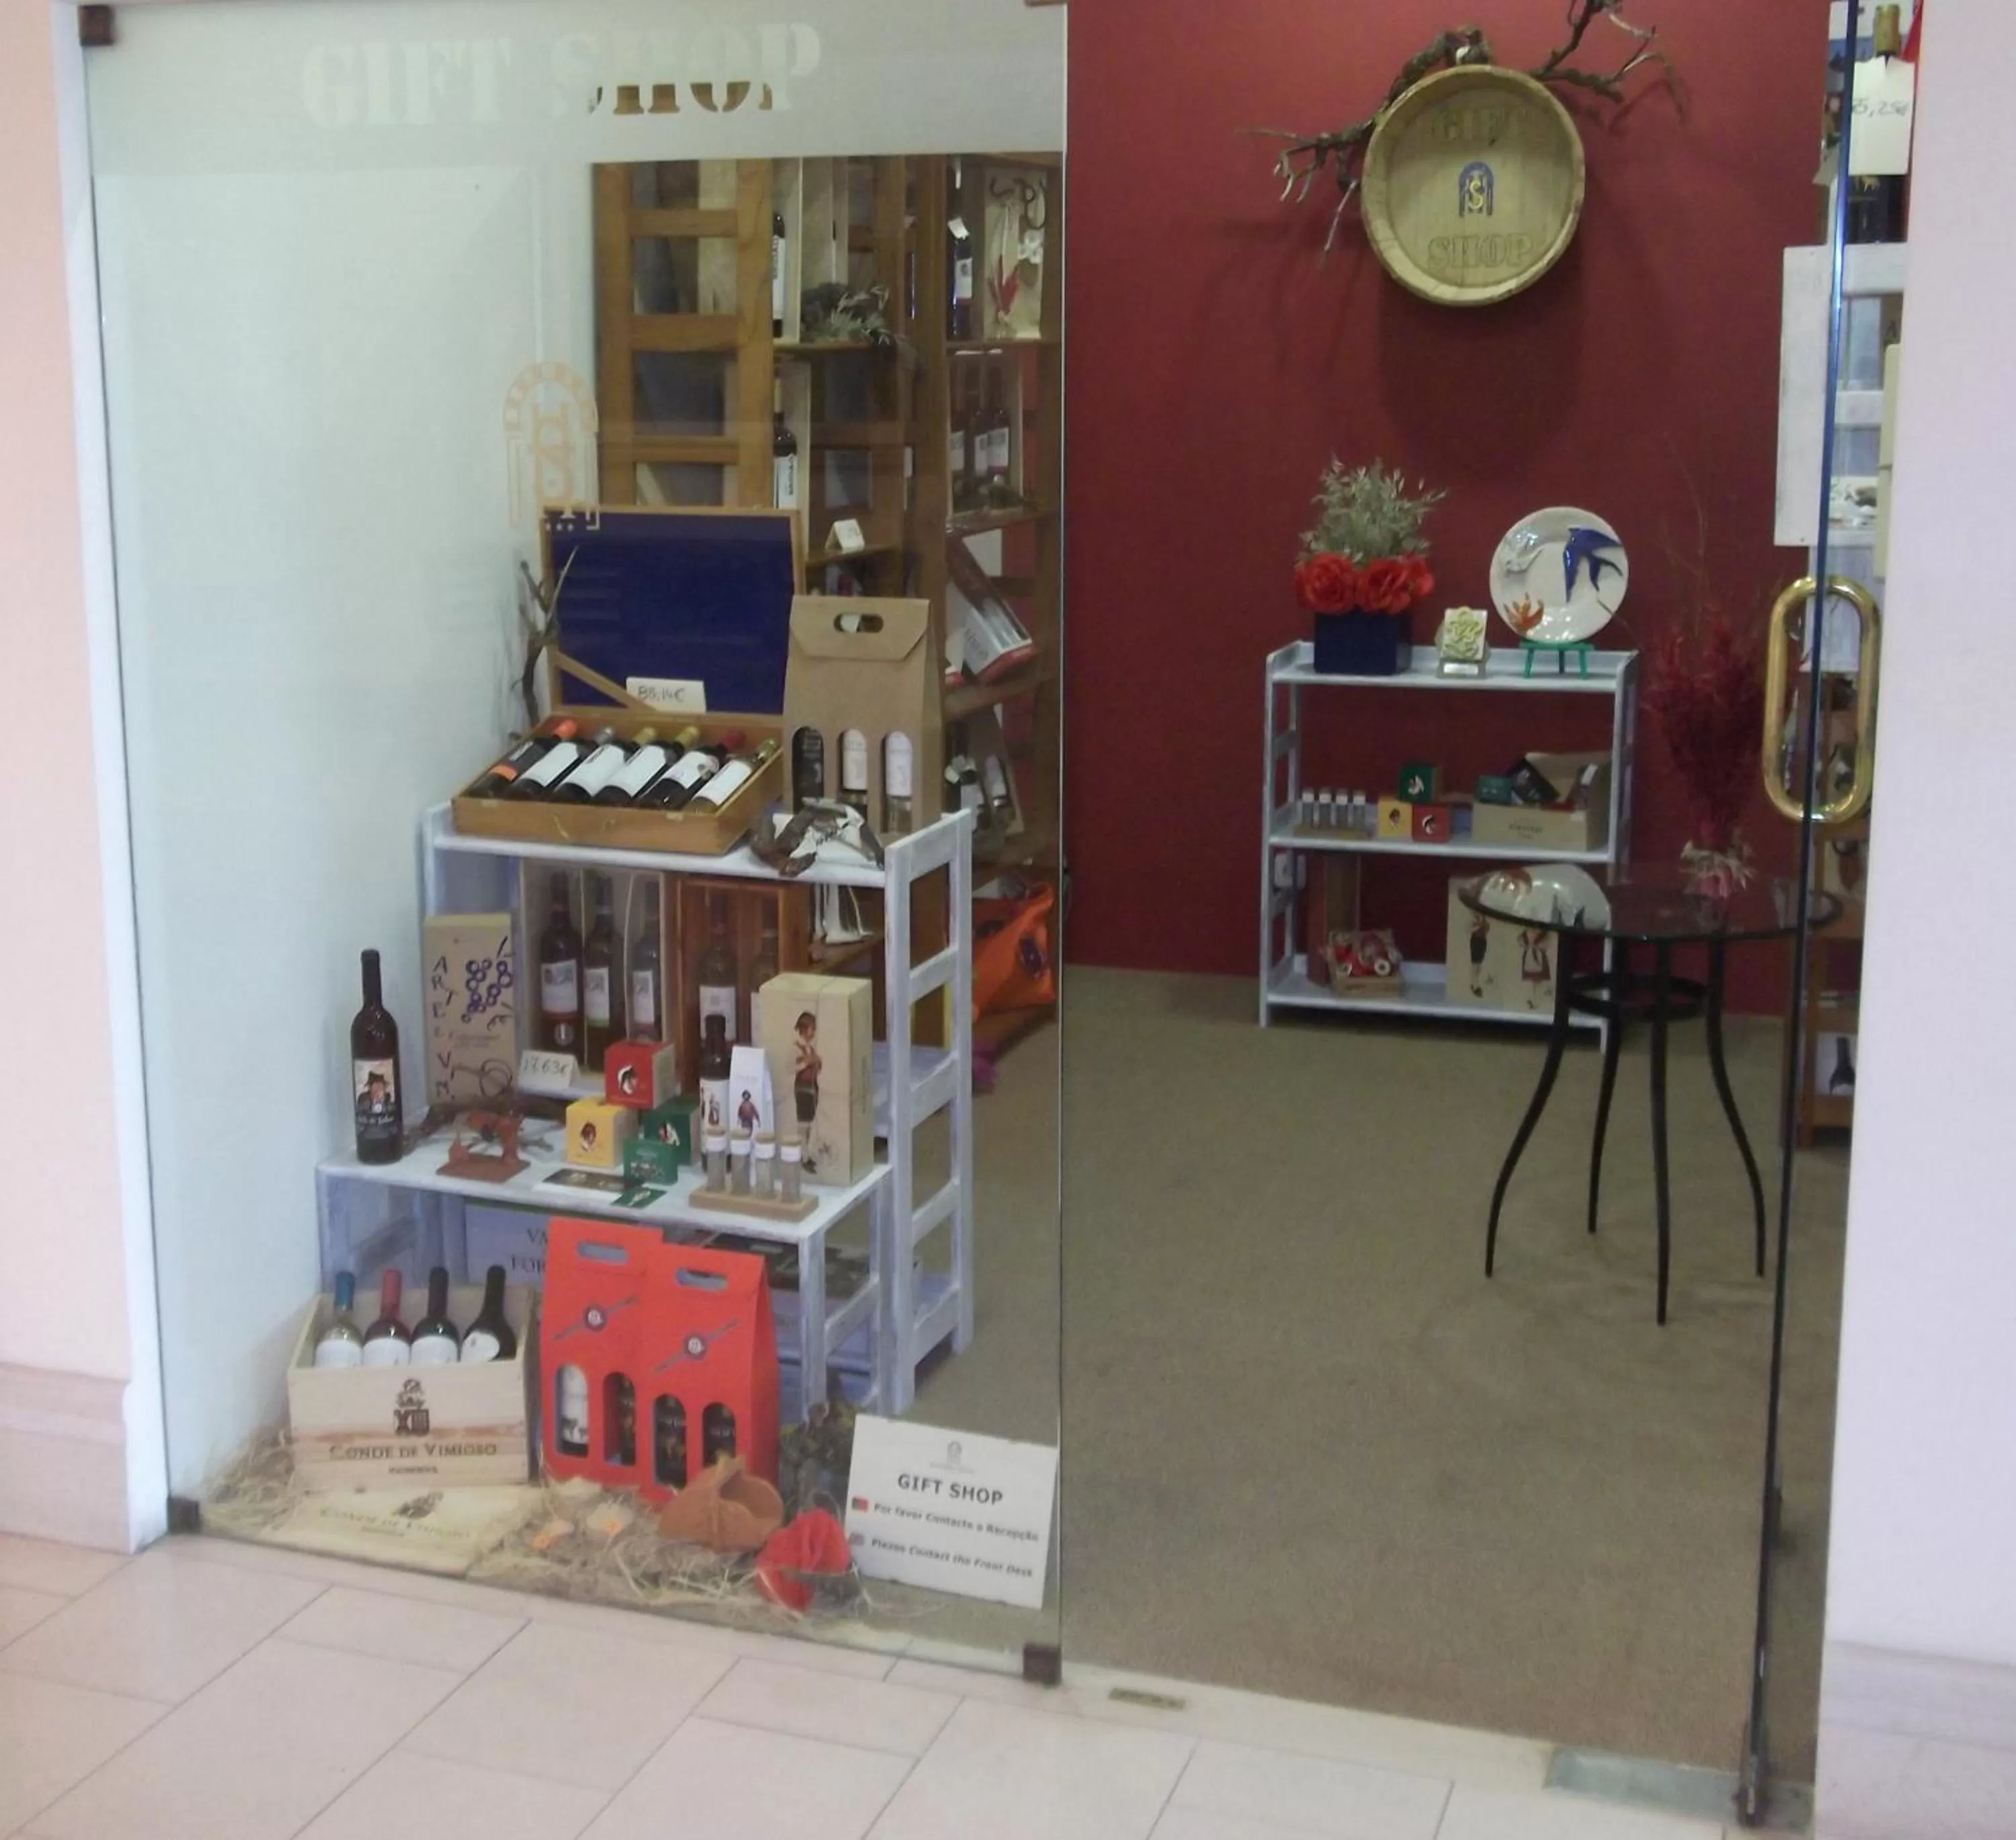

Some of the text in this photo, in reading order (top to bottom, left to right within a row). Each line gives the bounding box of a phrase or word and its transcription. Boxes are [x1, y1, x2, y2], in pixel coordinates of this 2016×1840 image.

[304, 23, 821, 127] GIFT SHOP
[1427, 233, 1534, 270] SHOP
[897, 1472, 1004, 1506] GIFT SHOP
[874, 1503, 892, 1514] Por
[872, 1538, 906, 1553] Please
[909, 1546, 951, 1562] Contact
[952, 1554, 972, 1566] the
[1005, 1564, 1034, 1578] Desk
